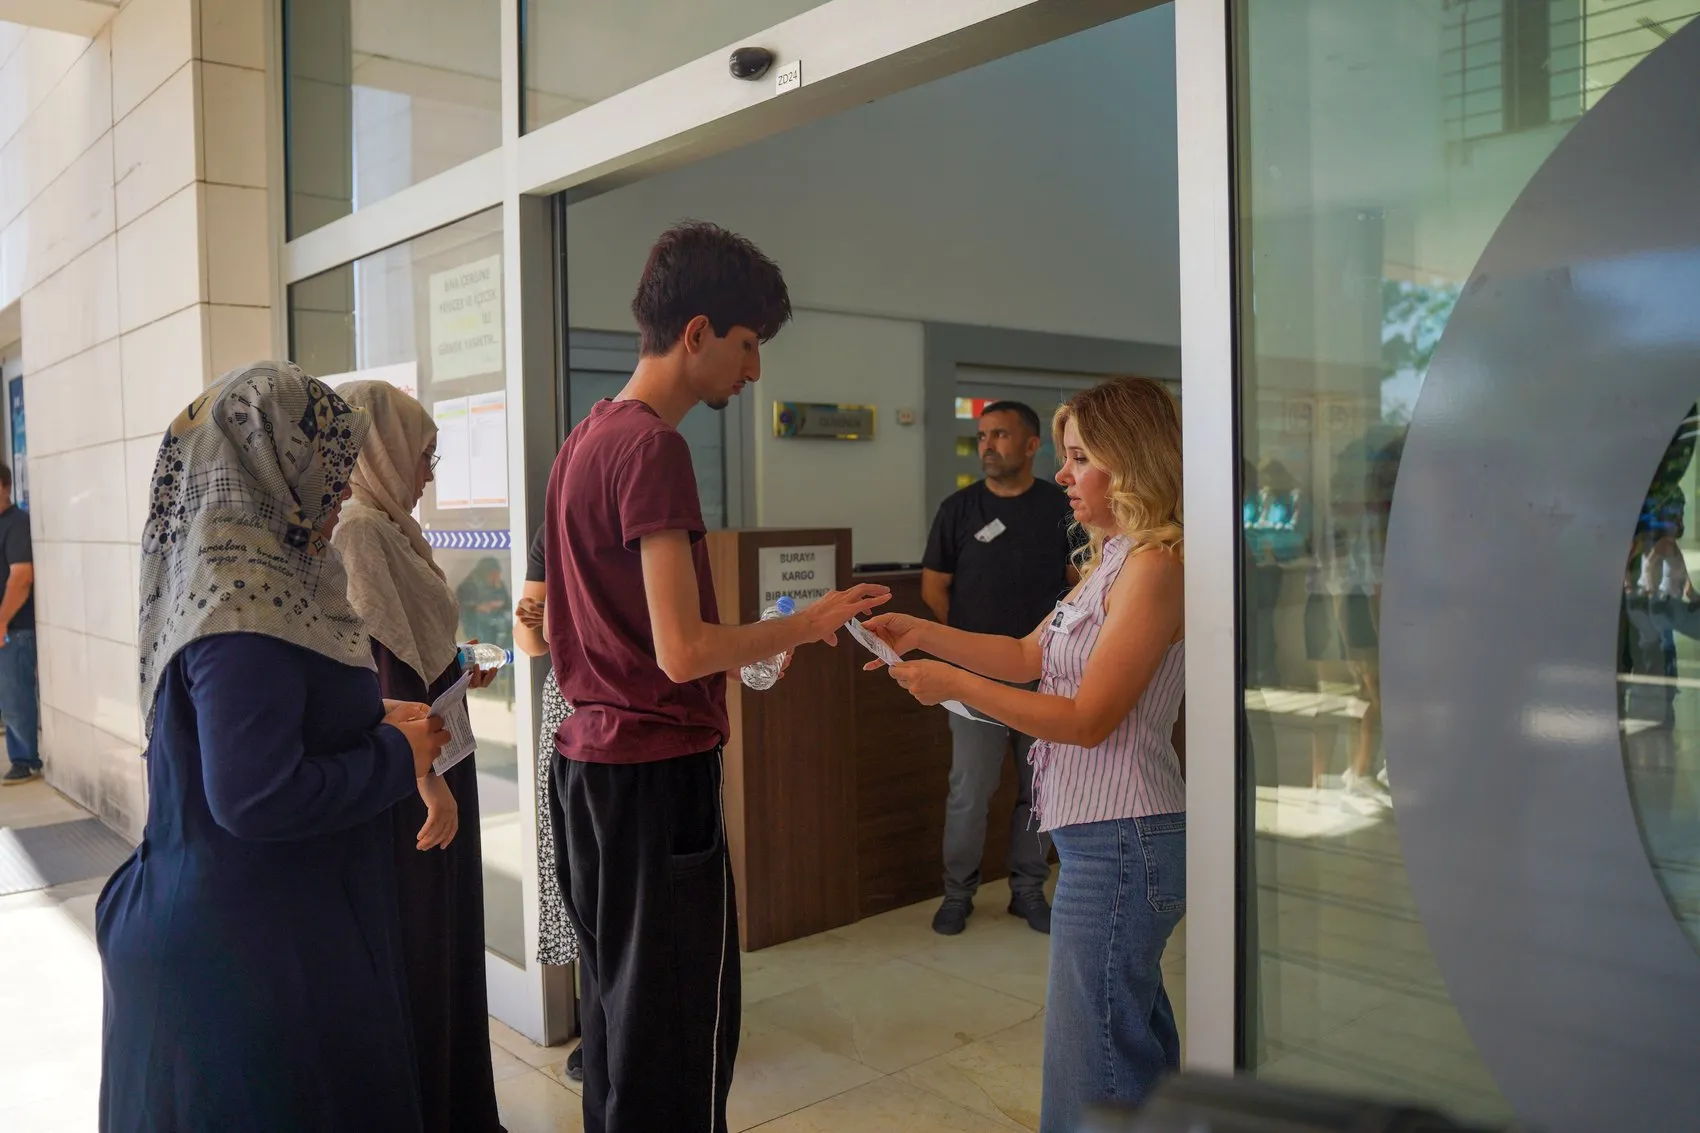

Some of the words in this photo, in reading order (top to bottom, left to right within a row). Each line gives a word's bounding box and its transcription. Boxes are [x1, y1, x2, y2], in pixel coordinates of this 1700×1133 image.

[778, 70, 798, 86] ZD24
[780, 552, 816, 563] BURAYA
[782, 570, 815, 581] KARGO
